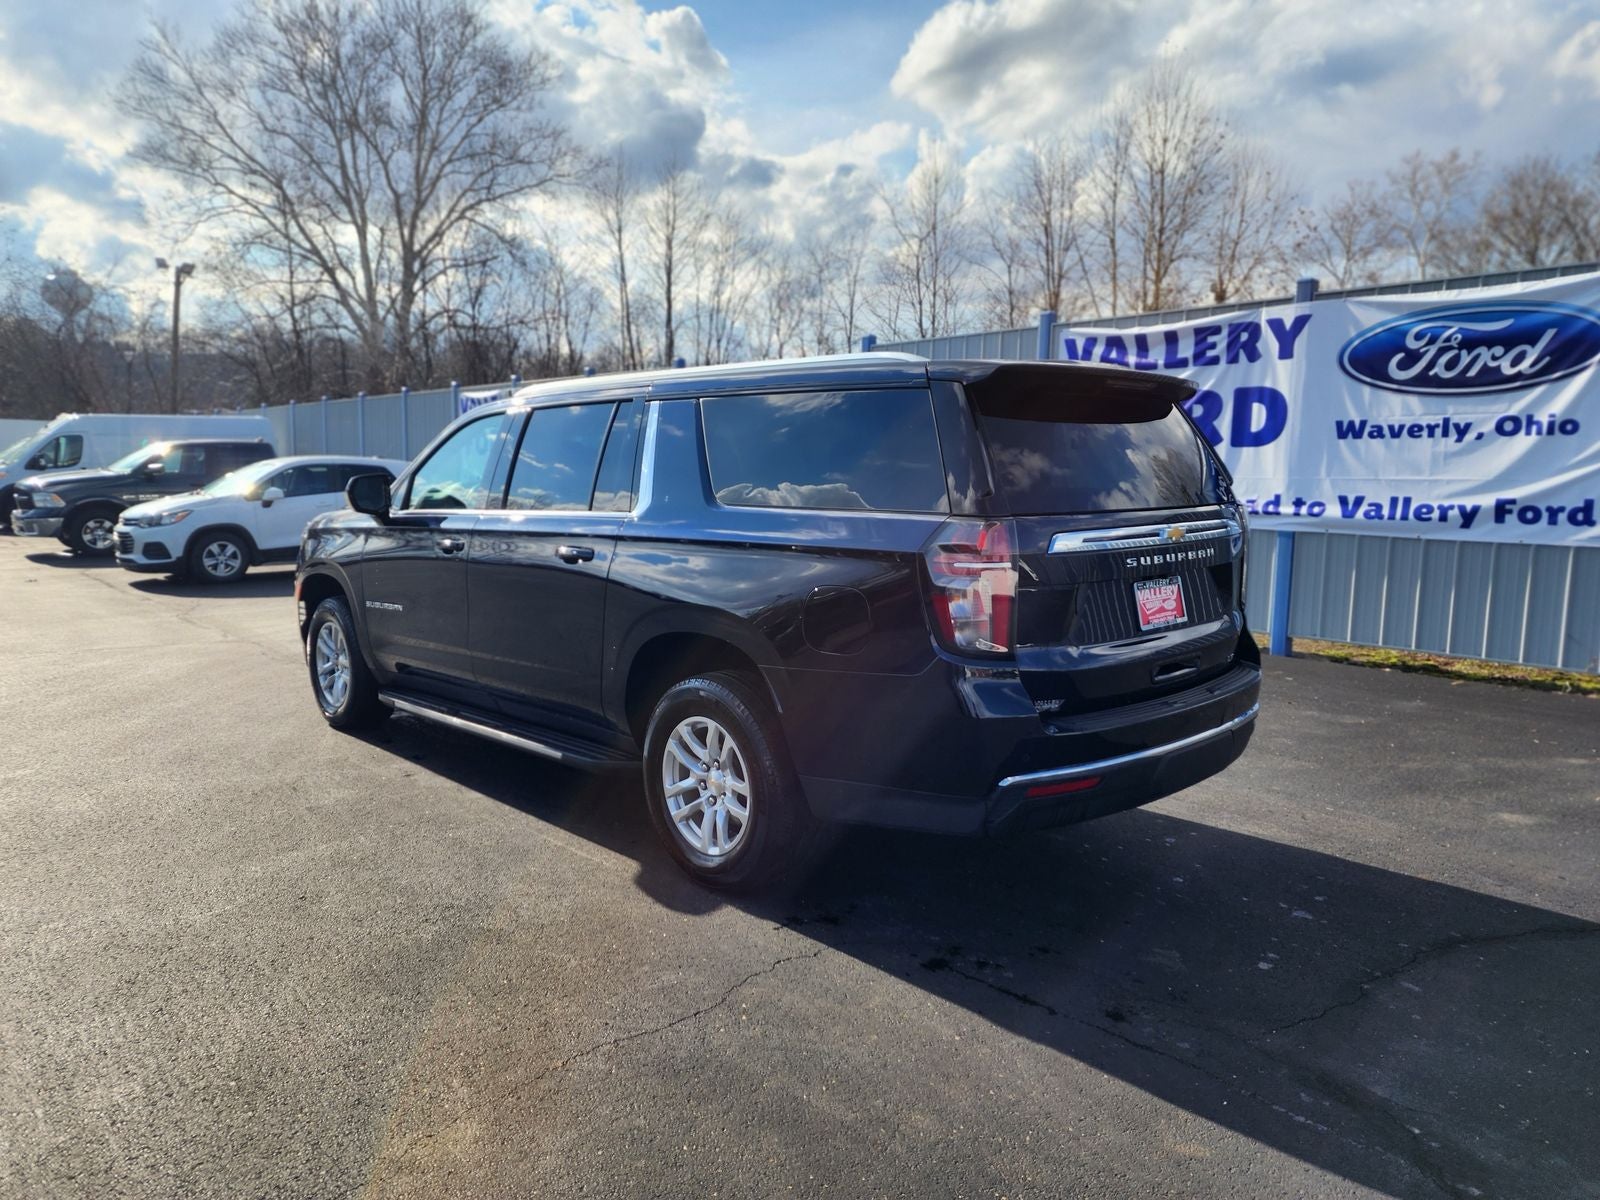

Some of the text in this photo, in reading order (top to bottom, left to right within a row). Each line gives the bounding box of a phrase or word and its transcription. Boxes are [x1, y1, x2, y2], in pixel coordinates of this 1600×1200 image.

[1064, 314, 1312, 370] VALLERY
[1387, 318, 1558, 381] Ford
[1179, 386, 1288, 448] RD
[1335, 414, 1580, 443] Waverly, Ohio
[1292, 497, 1326, 517] to
[1337, 495, 1482, 529] Vallery
[1493, 498, 1597, 527] Ford
[1126, 547, 1215, 568] SUBURBAN
[1138, 584, 1179, 601] VALLERY
